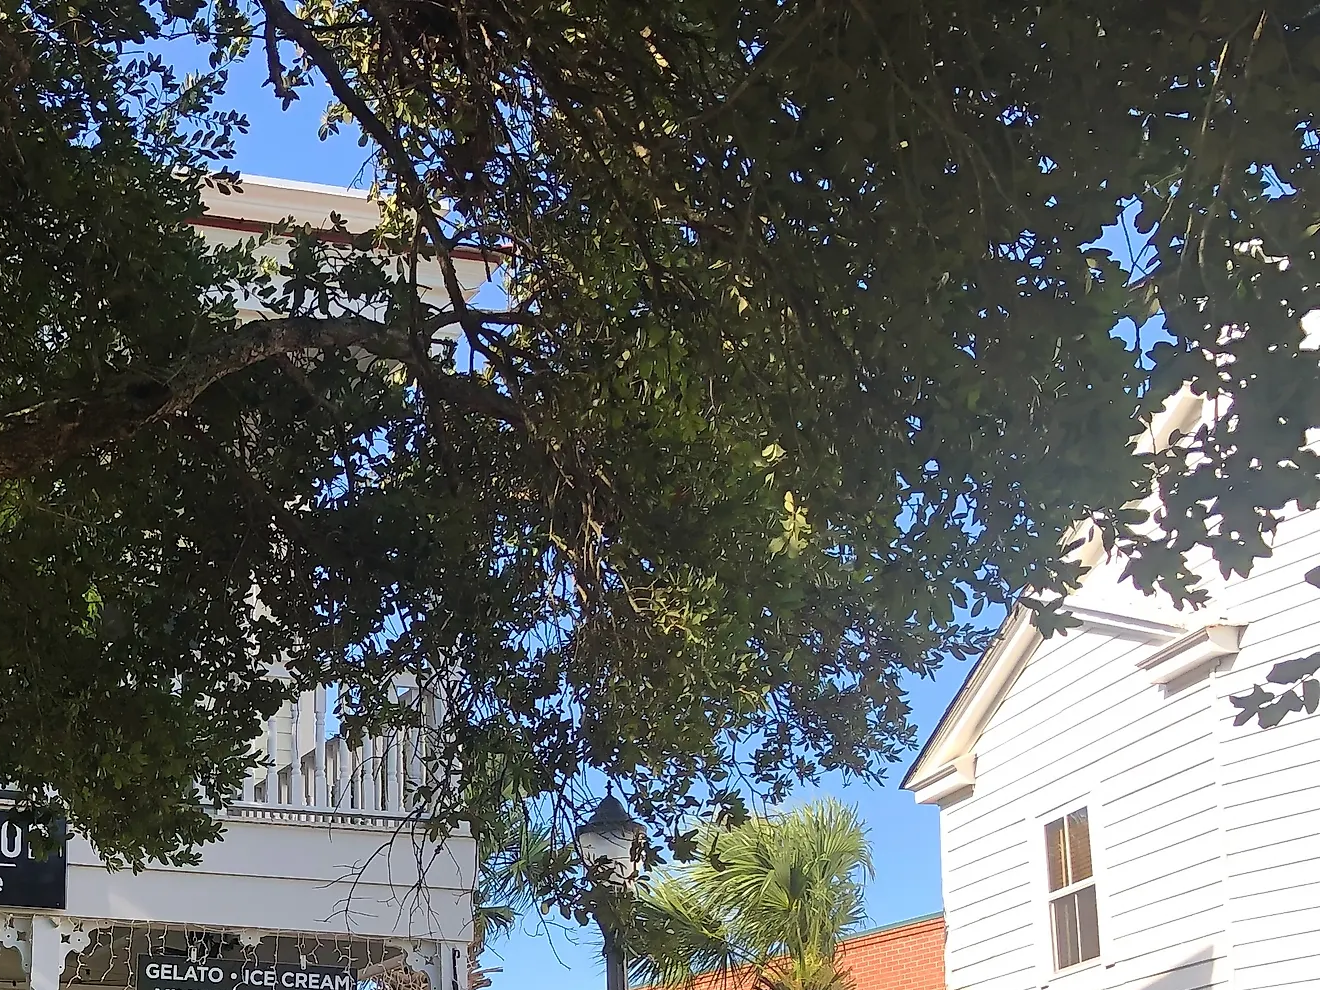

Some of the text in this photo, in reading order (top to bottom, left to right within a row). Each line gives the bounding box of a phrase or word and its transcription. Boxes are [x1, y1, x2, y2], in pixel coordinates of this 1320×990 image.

[145, 963, 351, 990] GELATO ICE CREAM
